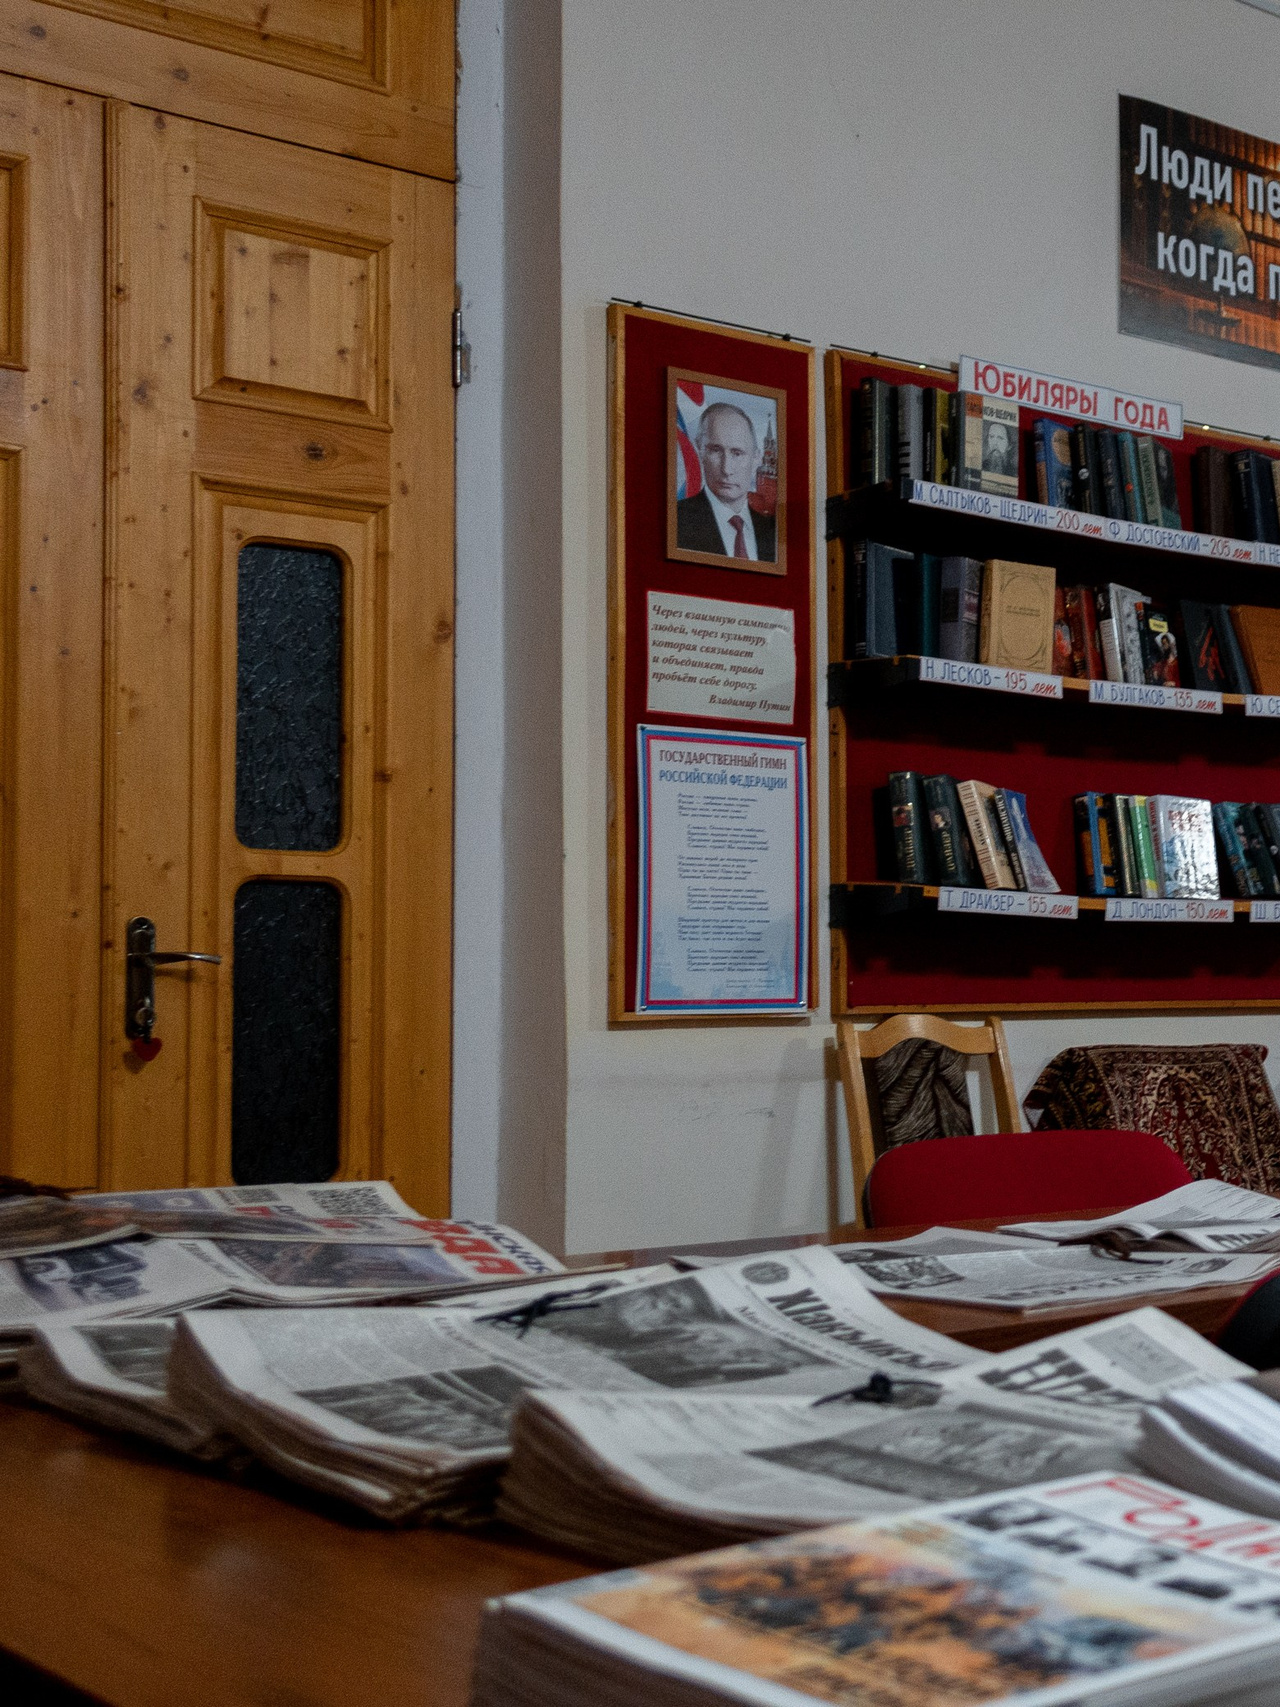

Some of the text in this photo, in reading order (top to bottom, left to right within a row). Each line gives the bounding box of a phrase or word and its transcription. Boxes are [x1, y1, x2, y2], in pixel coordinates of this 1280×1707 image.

[1134, 123, 1234, 204] Люди
[1156, 230, 1255, 297] когда
[973, 360, 1171, 432] ЮБИЛЯРЫ ГОДА
[914, 483, 925, 501] М.
[1082, 523, 1102, 537] лет
[1232, 548, 1252, 561] лет
[652, 604, 682, 618] Через
[685, 611, 736, 626] взаимную
[651, 623, 688, 635] людей,
[691, 628, 718, 642] через
[652, 639, 754, 658] которая связывает
[652, 655, 764, 676] и объединяет, правда
[651, 670, 697, 684] пробьёт
[699, 675, 721, 685] себе
[926, 662, 938, 679] Н.
[1032, 682, 1058, 697] лет
[709, 694, 791, 712] Владимир Путин
[1093, 683, 1107, 702] М.
[1195, 699, 1217, 712] лет
[1250, 697, 1266, 714] Ю.
[659, 749, 787, 770] ГОСУДАРСТВЕННЫЙ ГИМН
[659, 767, 788, 791] РОССИЙСКОЙ ФЕДЕРАЦИИ
[944, 890, 955, 908] Т.
[1050, 904, 1073, 916] лет
[1112, 902, 1127, 919] Д.
[1205, 908, 1229, 920] лет
[1254, 904, 1269, 920] Ш.
